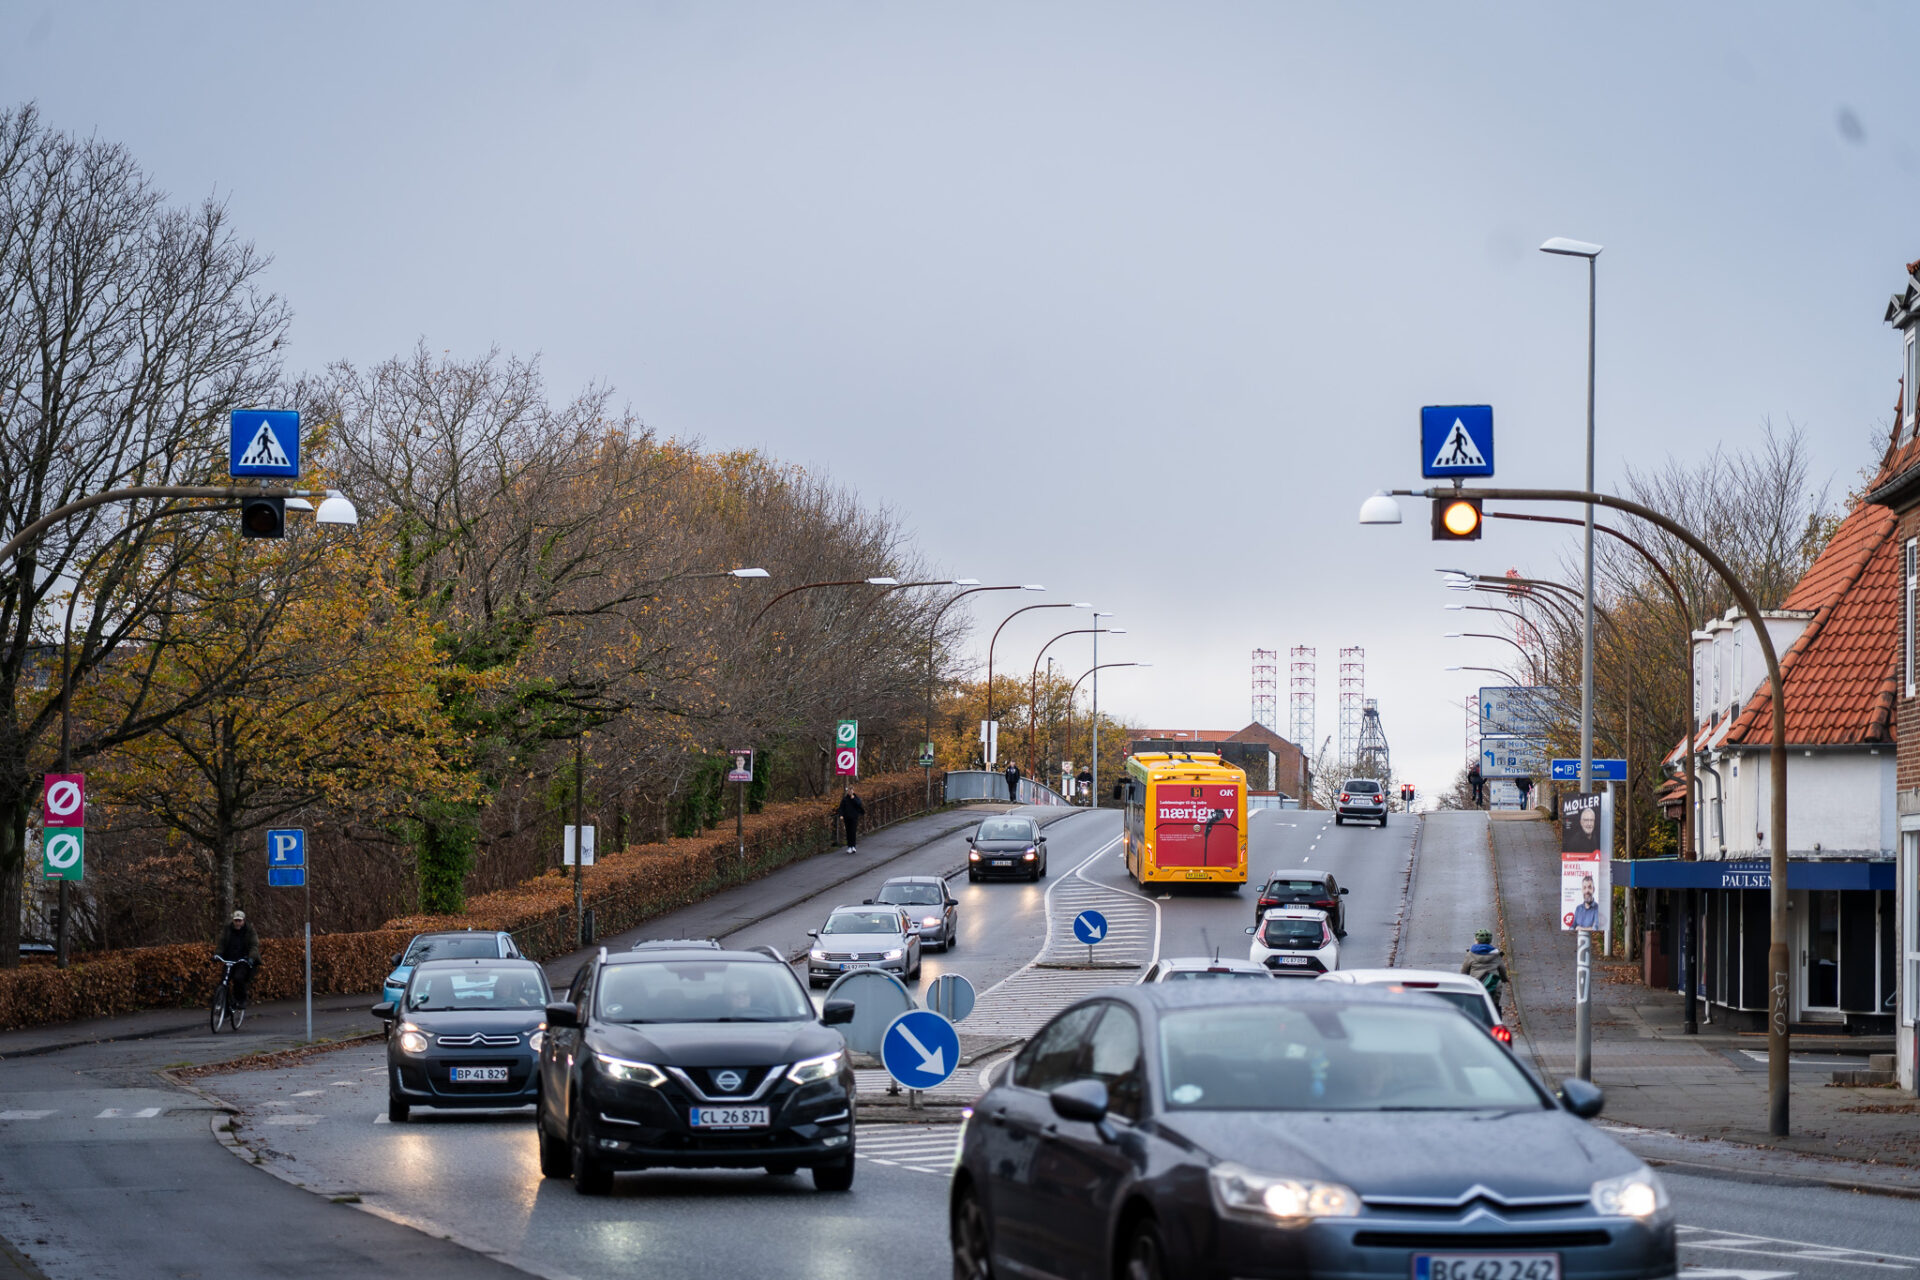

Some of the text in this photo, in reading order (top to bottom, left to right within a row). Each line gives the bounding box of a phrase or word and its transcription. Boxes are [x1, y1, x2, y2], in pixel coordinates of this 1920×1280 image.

[1219, 789, 1234, 797] OK
[1563, 796, 1600, 812] MØLLER
[274, 835, 297, 861] P
[1565, 915, 1573, 924] SF
[457, 1069, 506, 1079] BP 41 829
[701, 1110, 765, 1123] CL 26 871
[1433, 1260, 1554, 1280] BG 42 242
